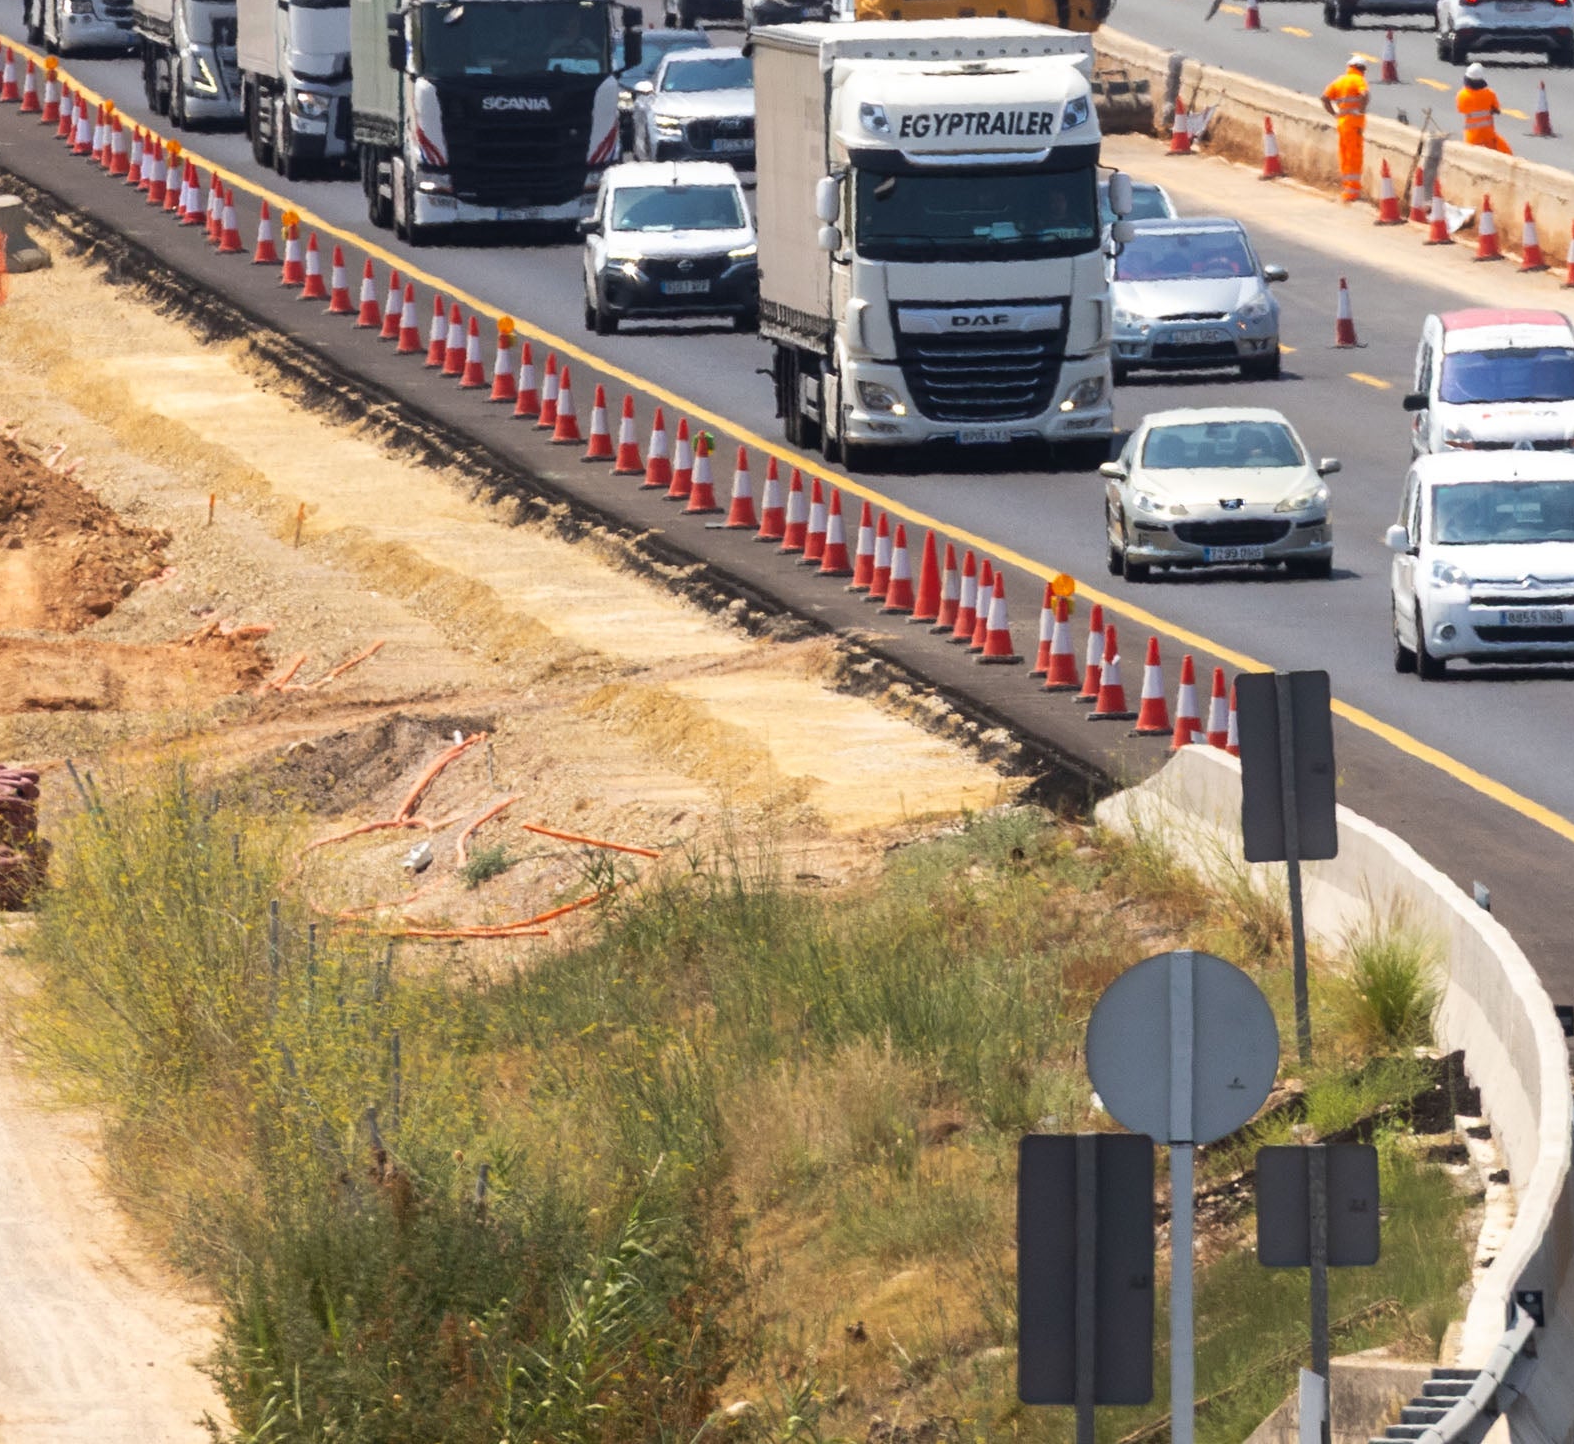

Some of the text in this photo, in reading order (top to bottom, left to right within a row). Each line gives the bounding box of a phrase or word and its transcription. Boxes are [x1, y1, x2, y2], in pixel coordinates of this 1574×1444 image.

[482, 95, 552, 111] SCANIA
[899, 111, 1054, 138] EGYPTRAILER
[951, 314, 1010, 327] DAF
